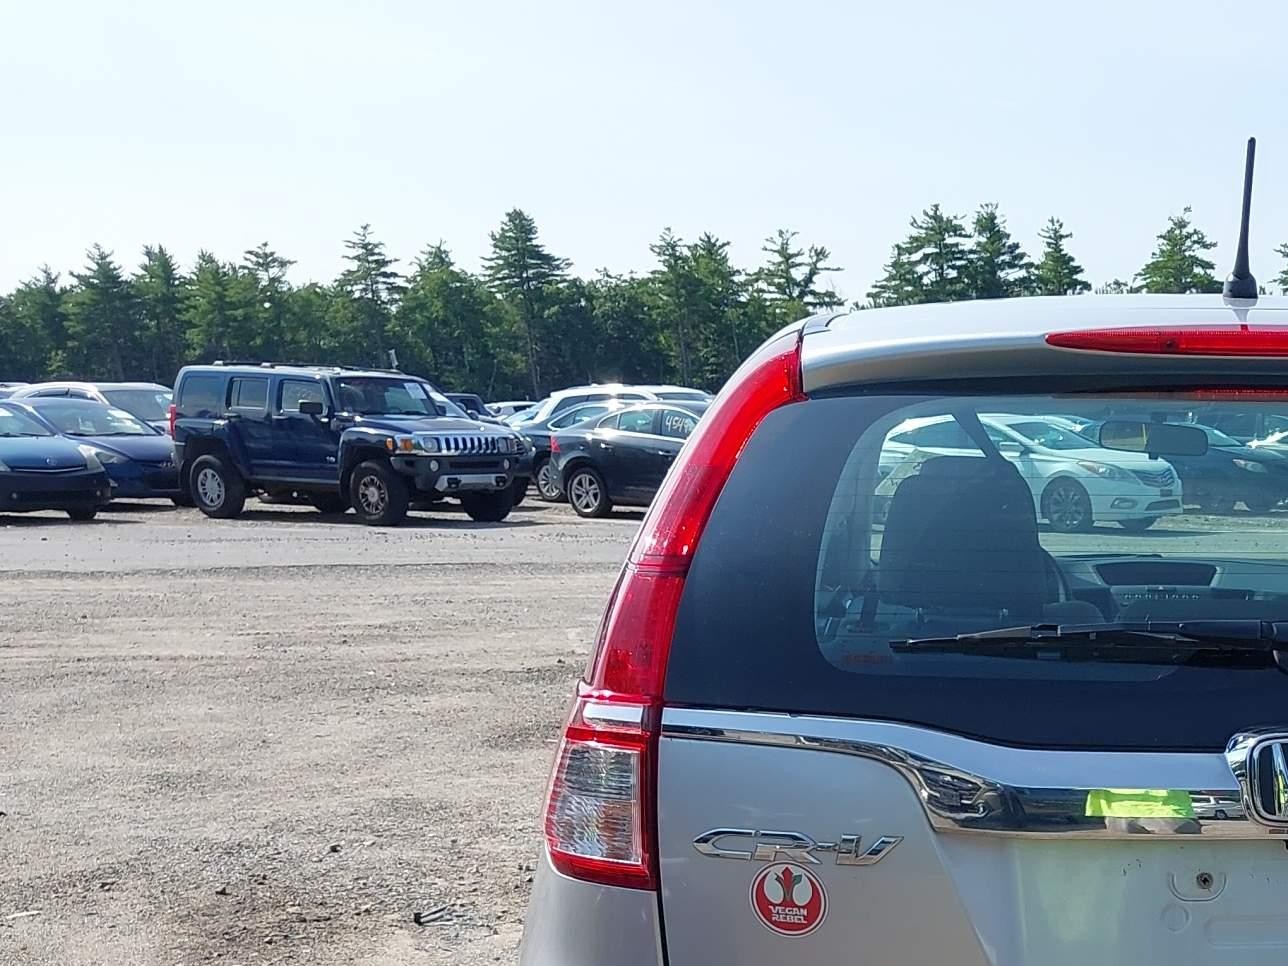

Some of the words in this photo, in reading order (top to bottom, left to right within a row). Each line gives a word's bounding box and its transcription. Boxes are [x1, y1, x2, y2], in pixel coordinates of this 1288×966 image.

[692, 827, 904, 865] CR-V
[768, 904, 807, 916] VEGAN
[771, 913, 808, 924] REBEL
